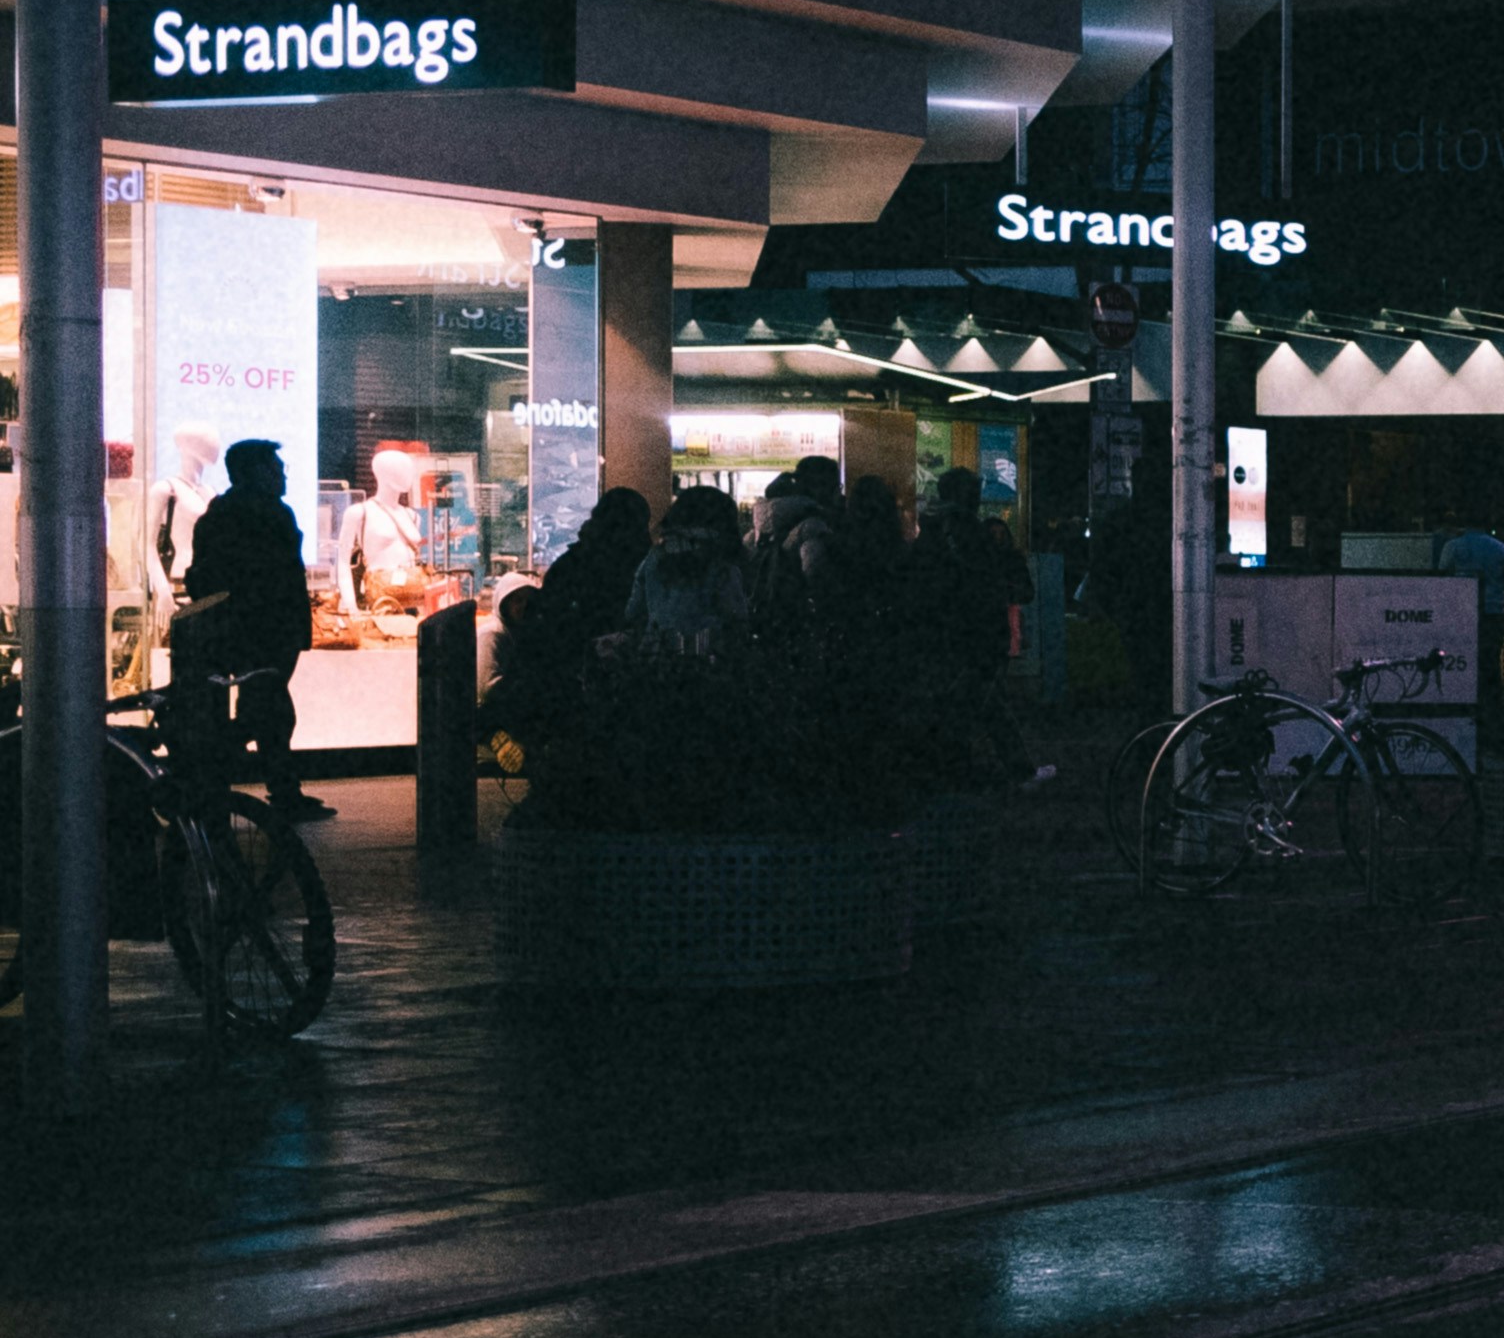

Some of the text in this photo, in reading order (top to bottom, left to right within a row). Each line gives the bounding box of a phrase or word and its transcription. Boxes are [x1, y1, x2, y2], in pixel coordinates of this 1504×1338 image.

[153, 2, 478, 83] Strandbags
[997, 193, 1308, 265] Stranags
[178, 361, 296, 391] 25% OFF
[1385, 609, 1433, 624] DOME
